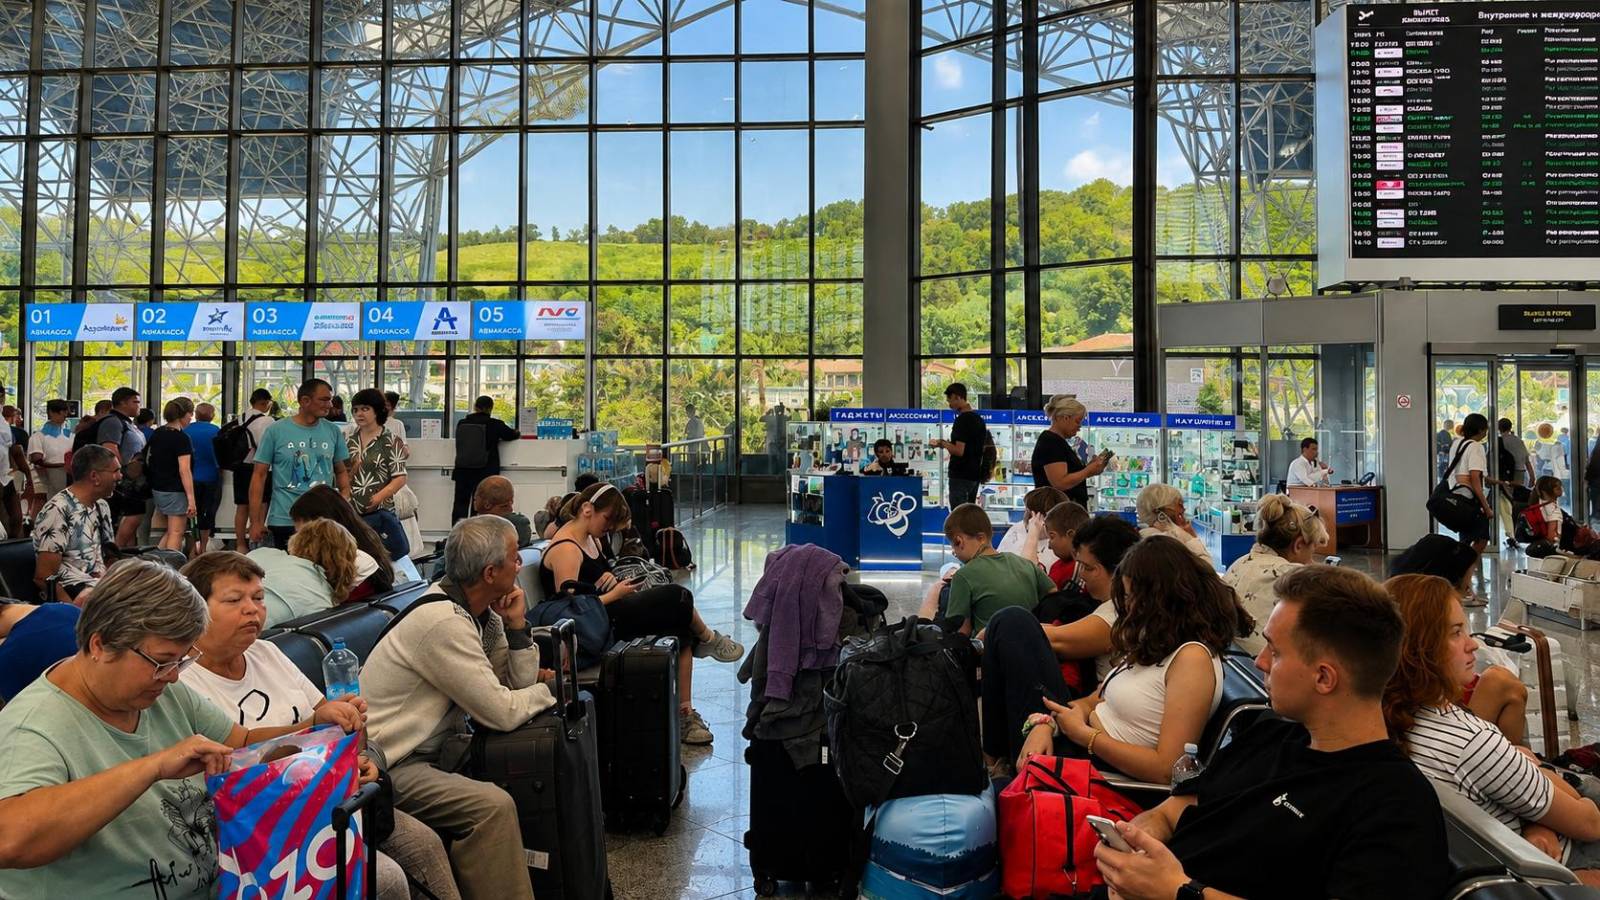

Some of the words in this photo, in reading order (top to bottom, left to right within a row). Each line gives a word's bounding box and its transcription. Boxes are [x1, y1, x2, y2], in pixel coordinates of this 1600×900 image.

[31, 309, 51, 324] 01
[142, 308, 166, 324] 02
[252, 308, 278, 324] 03
[368, 307, 394, 323] 04
[479, 306, 504, 322] 05
[835, 411, 883, 419] ГАДЖЕТЫ
